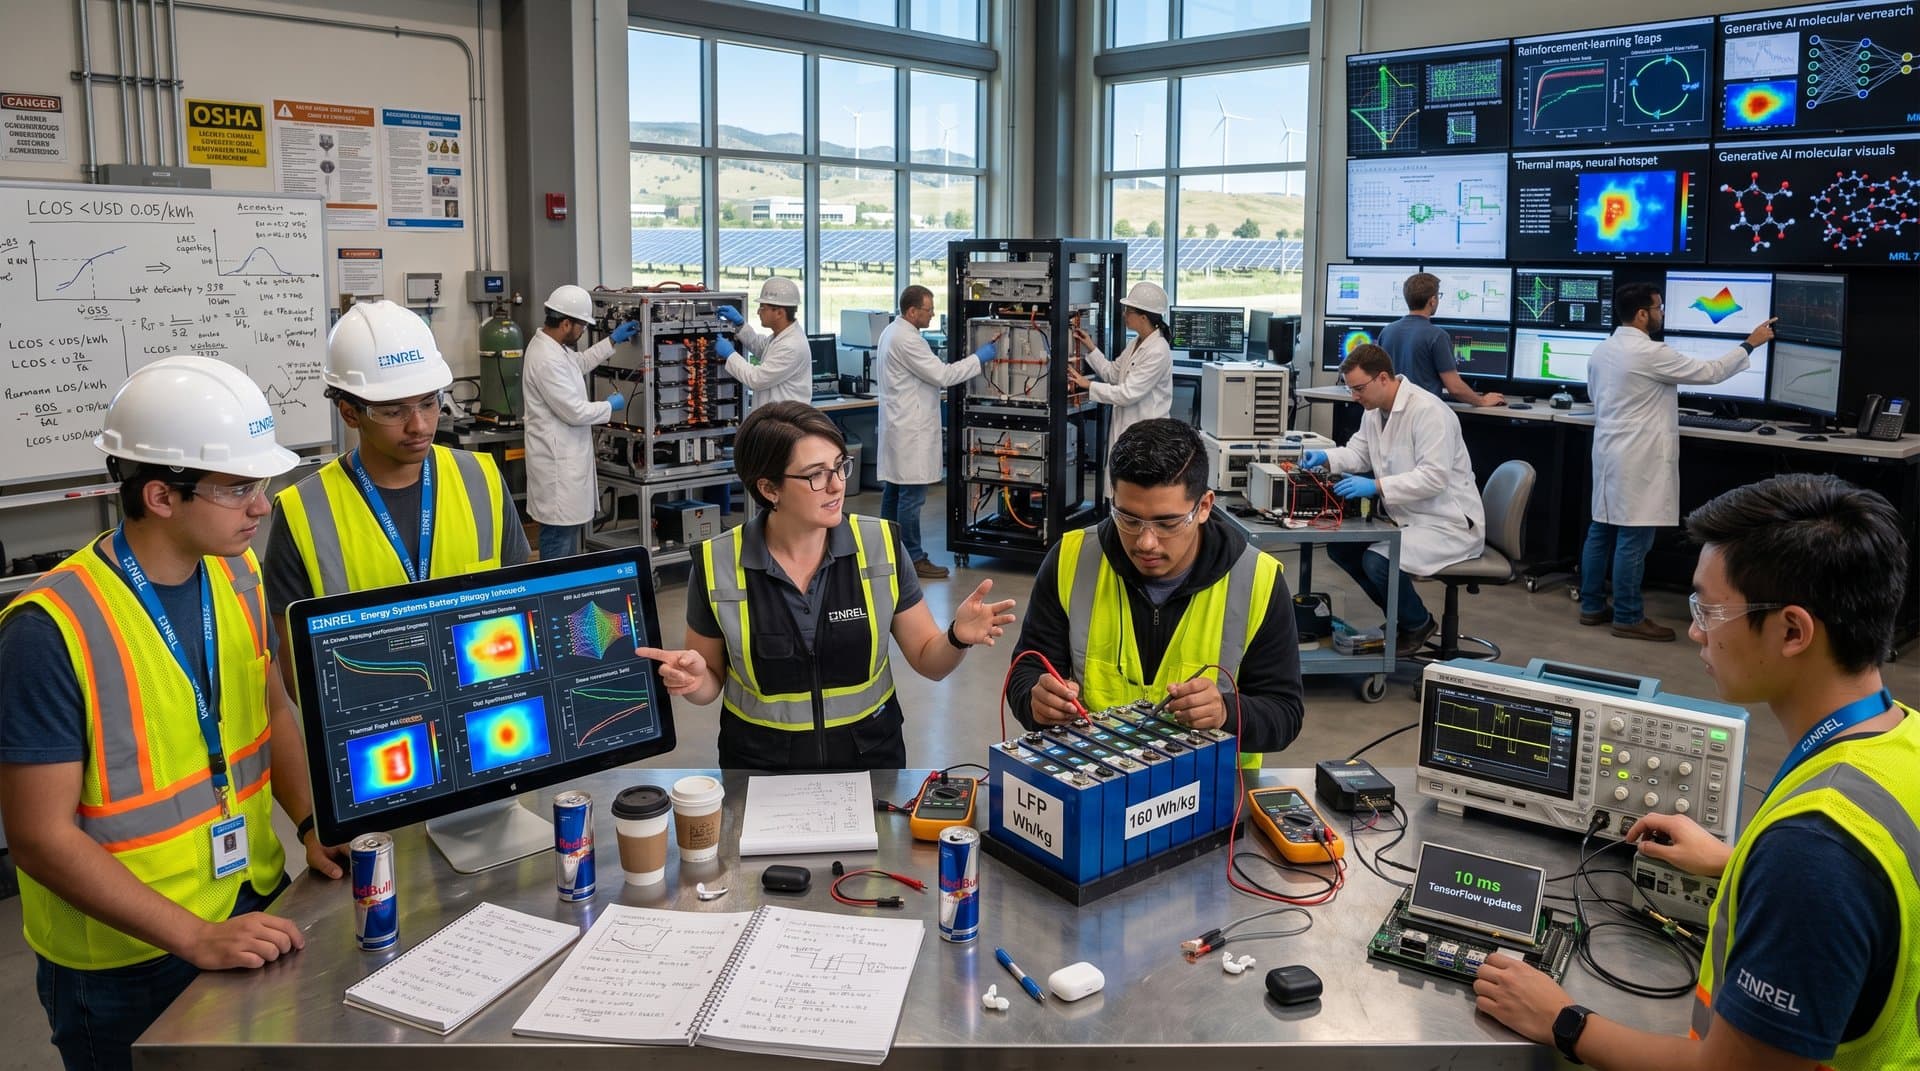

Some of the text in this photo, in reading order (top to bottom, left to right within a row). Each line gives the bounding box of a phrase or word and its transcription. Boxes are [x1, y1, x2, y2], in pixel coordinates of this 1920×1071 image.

[1724, 19, 1783, 35] Generative
[1799, 11, 1854, 28] molecular
[193, 105, 258, 128] OSHA
[1516, 159, 1554, 170] Thermal
[1585, 157, 1617, 168] neural
[1718, 151, 1778, 162] Generative
[1795, 147, 1852, 159] molecular
[1855, 144, 1896, 156] visuals
[27, 200, 74, 218] LCOS
[93, 200, 124, 217] USD
[130, 201, 195, 221] 0.05/kWh
[9, 338, 43, 350] LCOS
[11, 357, 47, 369] LCOS
[390, 349, 425, 365] NREL
[360, 609, 391, 621] Energy
[391, 603, 428, 616] Systems
[429, 597, 459, 610] Battery
[838, 607, 867, 619] NREL
[322, 614, 356, 629] NREL
[1017, 787, 1047, 816] LFP
[1129, 794, 1197, 829] 160 Wh/kg
[1012, 810, 1053, 848] Wh/kg
[1455, 870, 1501, 892] 10 ms
[1428, 881, 1523, 912] TensorFlow updates
[1748, 975, 1801, 1014] NREL
